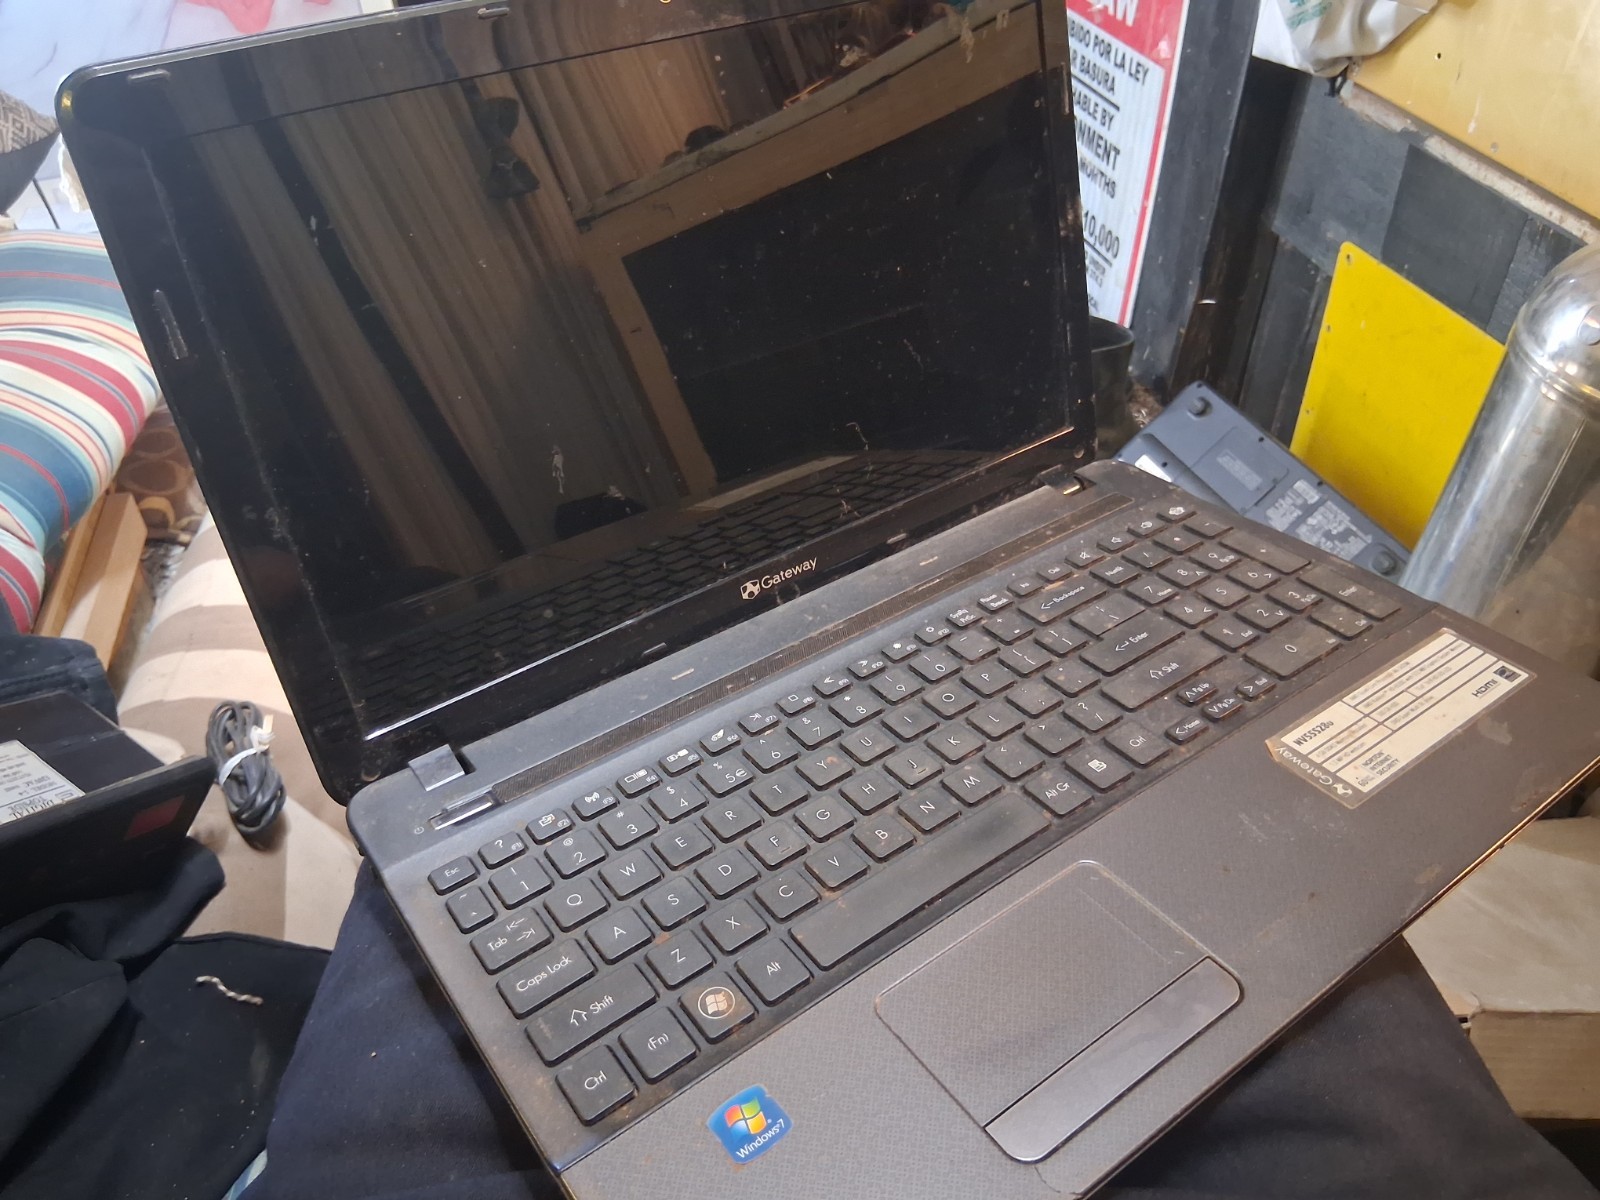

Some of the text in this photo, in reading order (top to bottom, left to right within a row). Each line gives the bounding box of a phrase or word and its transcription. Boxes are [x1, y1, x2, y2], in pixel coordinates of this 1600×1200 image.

[1092, 34, 1112, 62] POR
[1114, 47, 1126, 73] LA
[1128, 57, 1149, 86] LEY
[1079, 54, 1115, 96] BASURA
[1100, 107, 1114, 131] BY
[1083, 210, 1120, 259] 10,000
[761, 557, 817, 589] Gateway
[1053, 585, 1085, 603] Backspace
[1143, 585, 1153, 594] 7
[1215, 587, 1227, 596] 5
[1288, 591, 1301, 599] 3
[1183, 606, 1194, 614] 4
[1256, 608, 1269, 617] 2
[1128, 631, 1149, 643] Enter
[1284, 644, 1298, 653] 0
[1161, 661, 1180, 674] Shift
[980, 673, 990, 682] P
[895, 684, 906, 692] 9
[1471, 678, 1499, 698] HDMI
[855, 705, 867, 714] 8
[812, 726, 821, 737] 7
[860, 736, 873, 747] U
[947, 736, 961, 746] K
[1129, 735, 1147, 747] Ctrl
[771, 750, 781, 759] 6
[816, 759, 828, 769] Y
[908, 759, 917, 769] J
[1275, 746, 1333, 786] Gateway
[725, 770, 738, 783] 5
[963, 775, 981, 789] M
[666, 786, 676, 795] $
[771, 784, 783, 794] T
[861, 783, 876, 795] H
[1044, 788, 1058, 800] Alt
[680, 797, 689, 807] 4
[919, 801, 936, 814] N
[724, 810, 737, 821] R
[816, 809, 831, 820] G
[626, 823, 638, 835] 3
[874, 829, 889, 840] B
[511, 842, 523, 851] (F1)
[562, 837, 574, 847] @
[674, 836, 688, 848] E
[769, 835, 779, 847] F
[573, 851, 587, 864] 2
[827, 856, 840, 867] V
[444, 867, 460, 878] Esc
[619, 862, 636, 877] W
[717, 864, 732, 877] D
[778, 885, 794, 898] C
[566, 893, 583, 906] Q
[667, 893, 680, 906] S
[725, 915, 741, 930] X
[613, 926, 627, 939] A
[487, 937, 508, 951] Tab
[670, 948, 687, 963] Z
[515, 955, 572, 993] Caps Lock
[766, 961, 781, 976] Alt
[589, 995, 614, 1014] Shift
[647, 1033, 669, 1051] (Fn)
[584, 1070, 607, 1090] Ctrl
